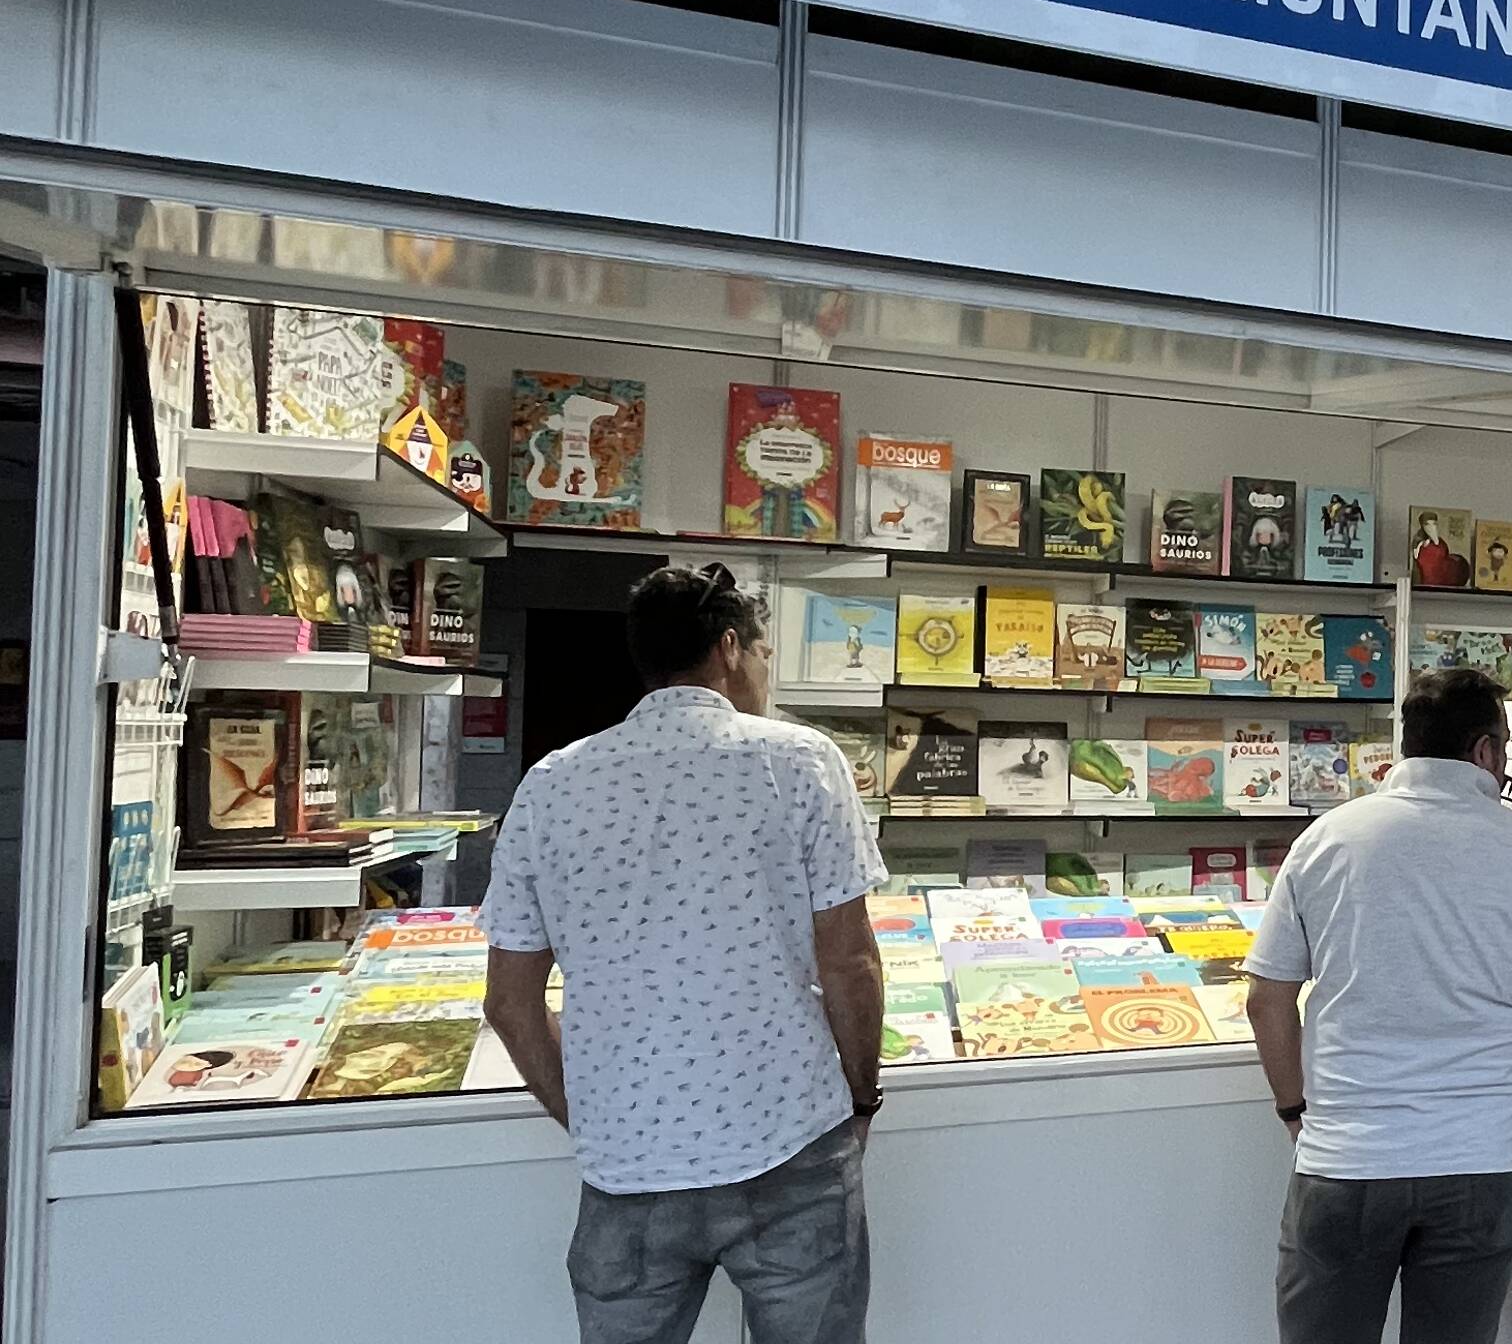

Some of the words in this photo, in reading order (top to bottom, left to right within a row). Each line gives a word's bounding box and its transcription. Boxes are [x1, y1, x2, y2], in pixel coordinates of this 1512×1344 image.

[872, 441, 941, 467] bosque
[1160, 534, 1198, 547] DINO
[1160, 548, 1211, 560] SAURIOS
[386, 610, 409, 627] DIN
[430, 613, 463, 628] DINO
[1205, 613, 1247, 632] SIMÓN
[429, 631, 474, 644] SAURIOS
[1234, 729, 1274, 744] SUPER
[391, 926, 485, 946] bosqu
